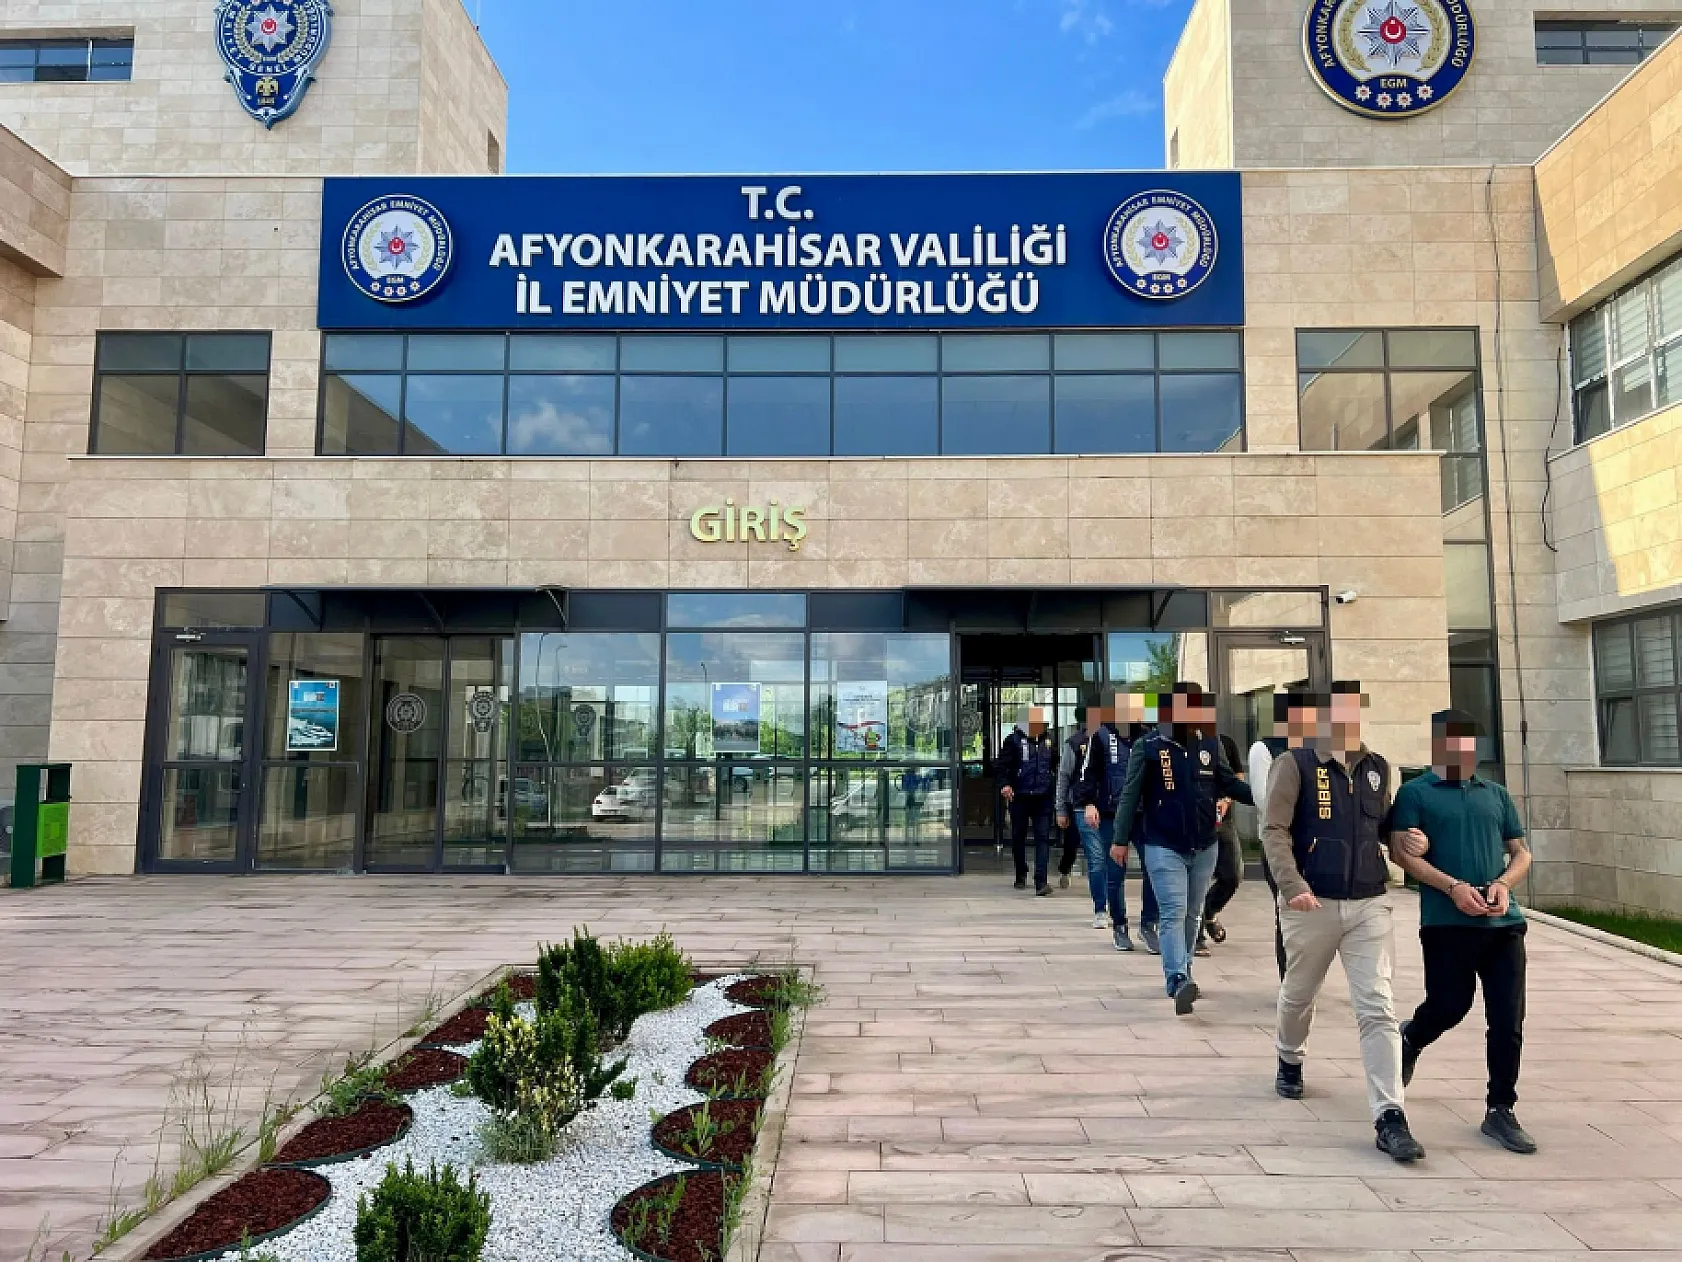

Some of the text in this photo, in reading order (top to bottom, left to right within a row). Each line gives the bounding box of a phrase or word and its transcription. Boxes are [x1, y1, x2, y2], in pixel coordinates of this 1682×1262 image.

[1379, 77, 1407, 89] EGM
[741, 186, 814, 220] T.C.
[489, 223, 1067, 267] AFYONKARAHİSAR VALİLİĞİ
[516, 271, 1040, 314] İL EMNİYET MÜDÜRLÜĞÜ
[690, 498, 807, 552] GİRİŞ
